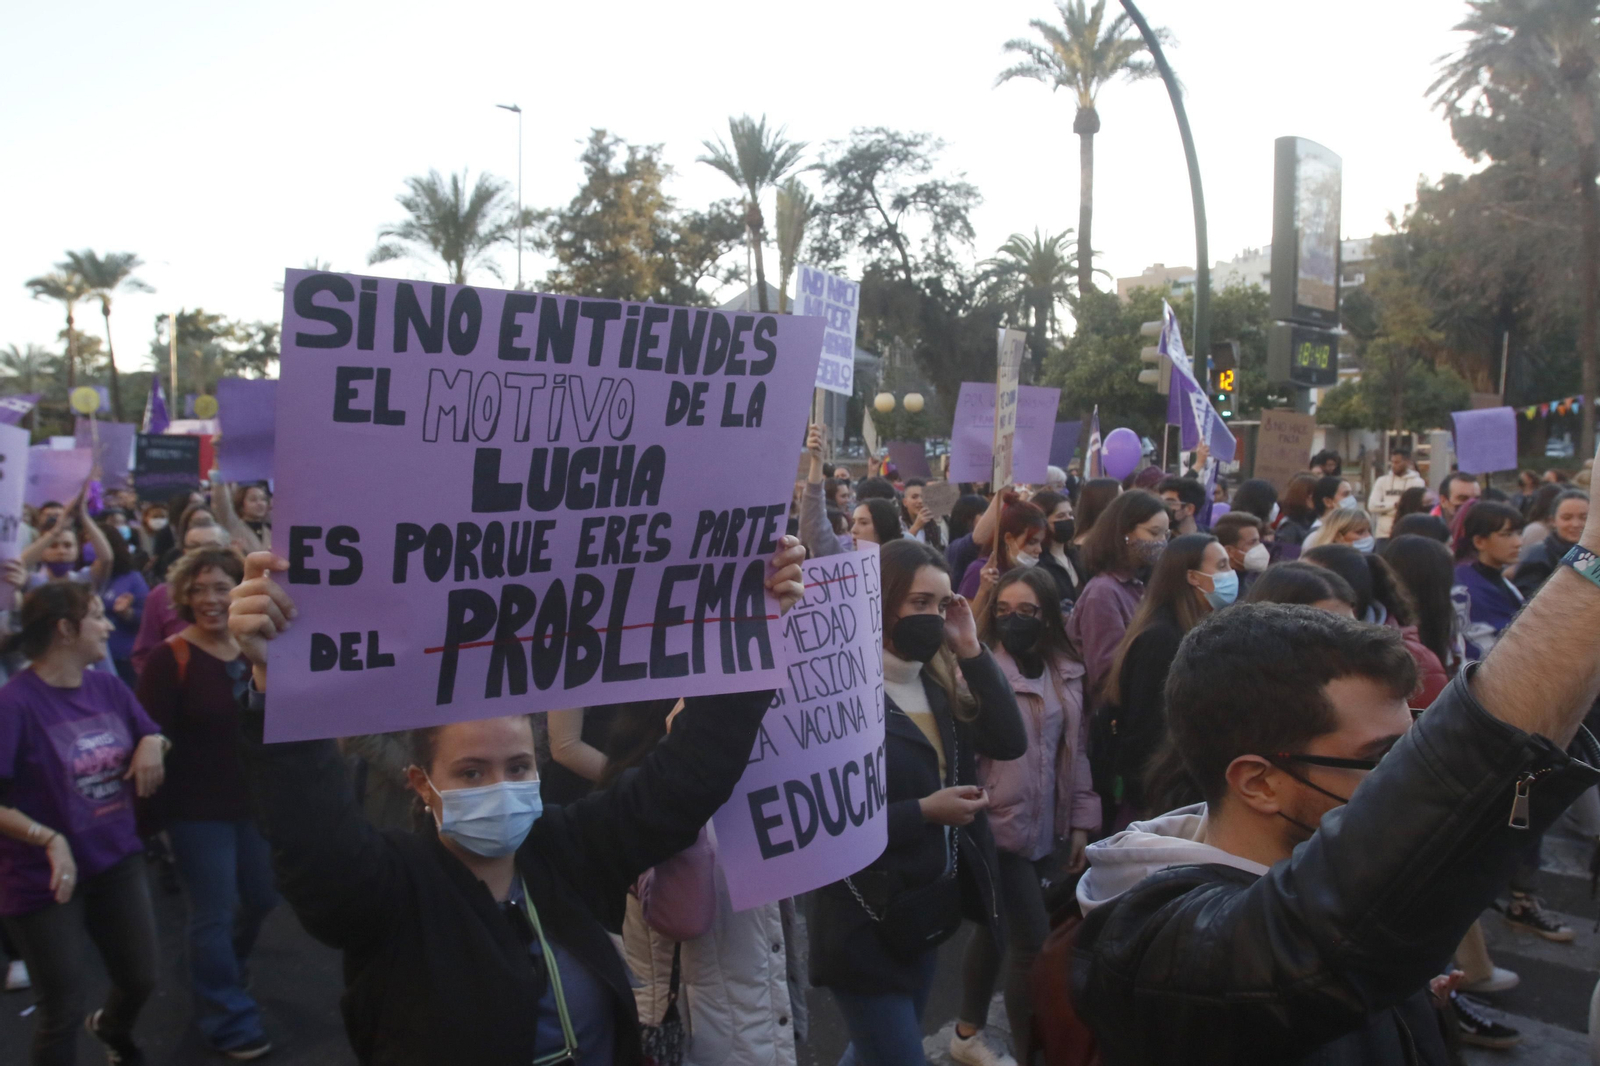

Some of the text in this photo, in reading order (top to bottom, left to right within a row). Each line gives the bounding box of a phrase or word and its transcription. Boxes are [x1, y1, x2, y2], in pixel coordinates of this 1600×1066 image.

[802, 267, 825, 298] NO
[393, 282, 483, 356] NO
[333, 366, 406, 425] EL
[665, 381, 709, 427] DE
[720, 381, 766, 428] LA
[1219, 369, 1234, 391] 12
[472, 444, 666, 513] LUCHA
[288, 503, 786, 586] ES PORQUE ERES PARTE
[794, 554, 880, 610] ISMO ES
[310, 559, 775, 706] DEL PROBLEMA
[782, 603, 857, 653] MEDAD
[783, 695, 868, 750] VACUNA
[747, 741, 888, 860] EDUCAC
